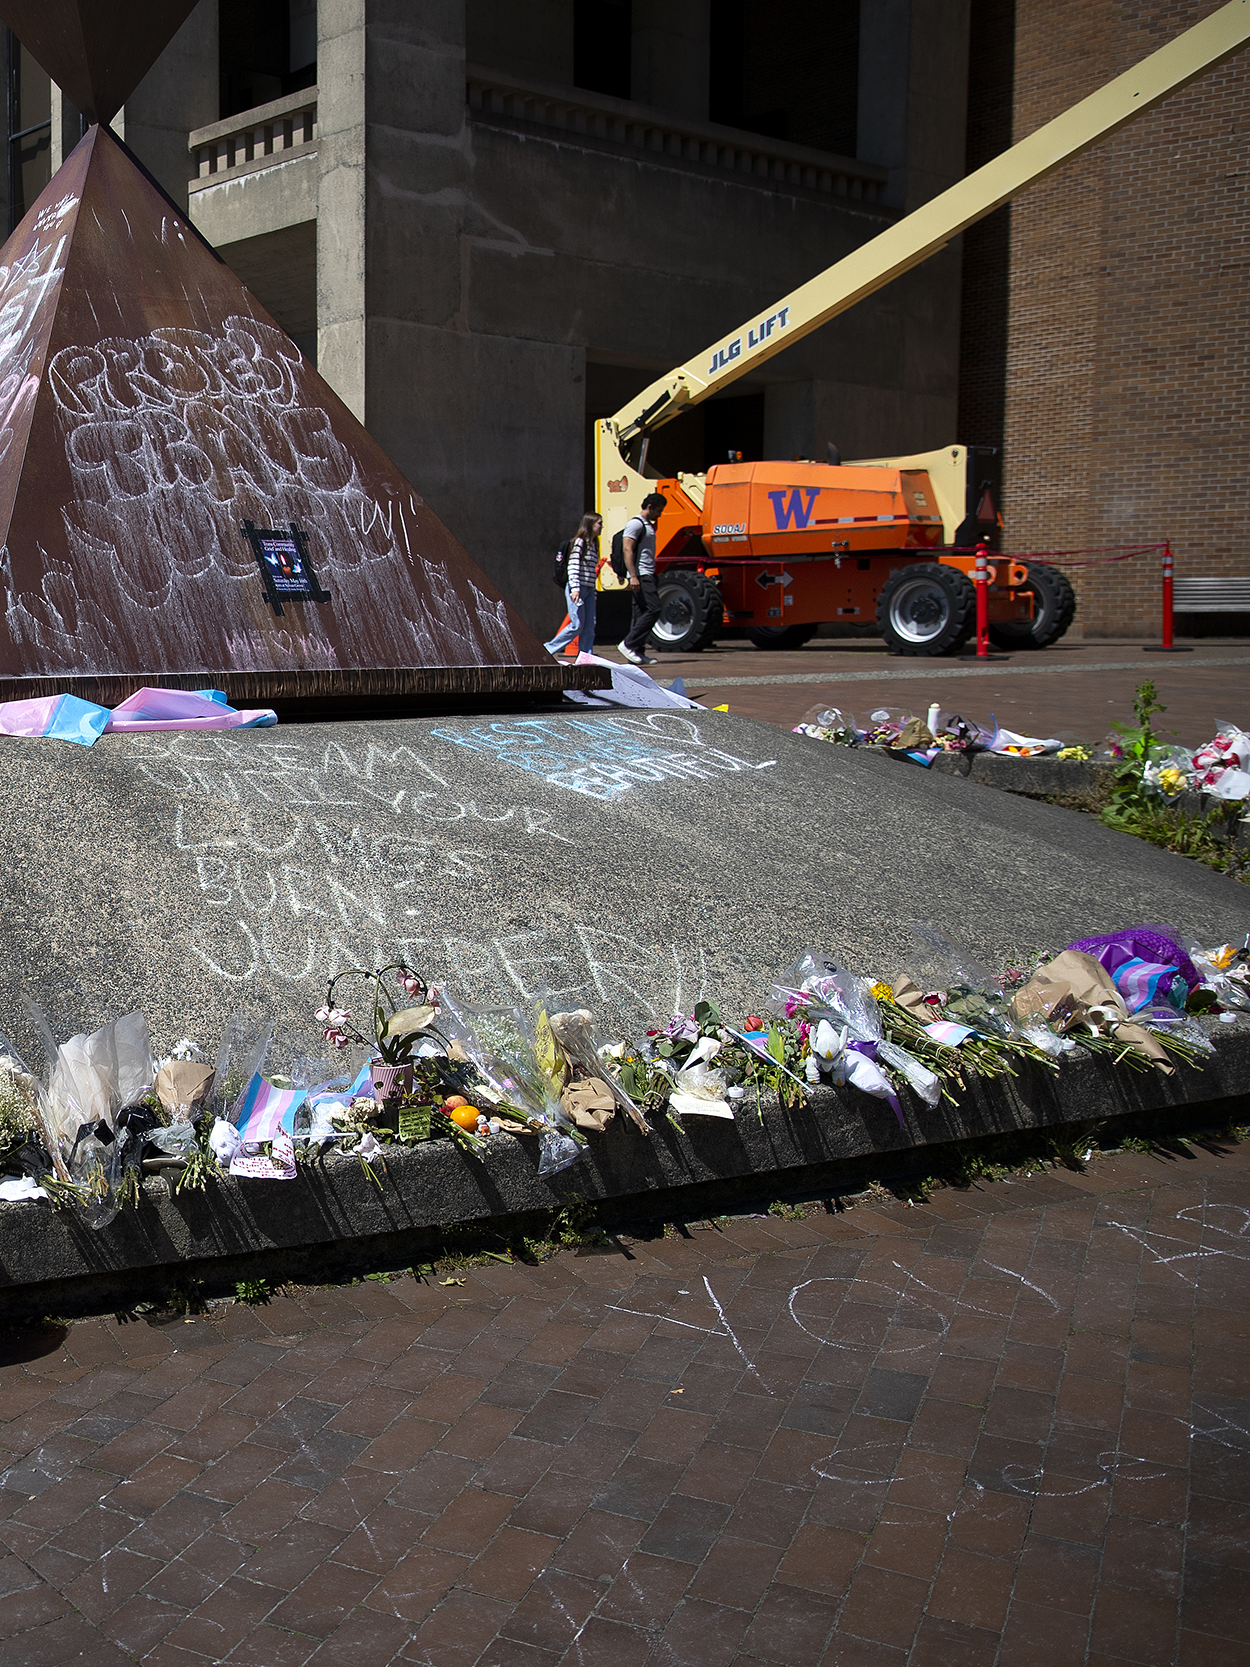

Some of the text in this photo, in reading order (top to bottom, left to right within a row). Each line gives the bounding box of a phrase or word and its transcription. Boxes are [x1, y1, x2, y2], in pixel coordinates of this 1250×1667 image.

[708, 305, 790, 375] JLG LIFT
[767, 487, 821, 530] W
[129, 735, 450, 787] SCREAM
[431, 718, 627, 753] REST IN
[356, 780, 576, 846] YOUR
